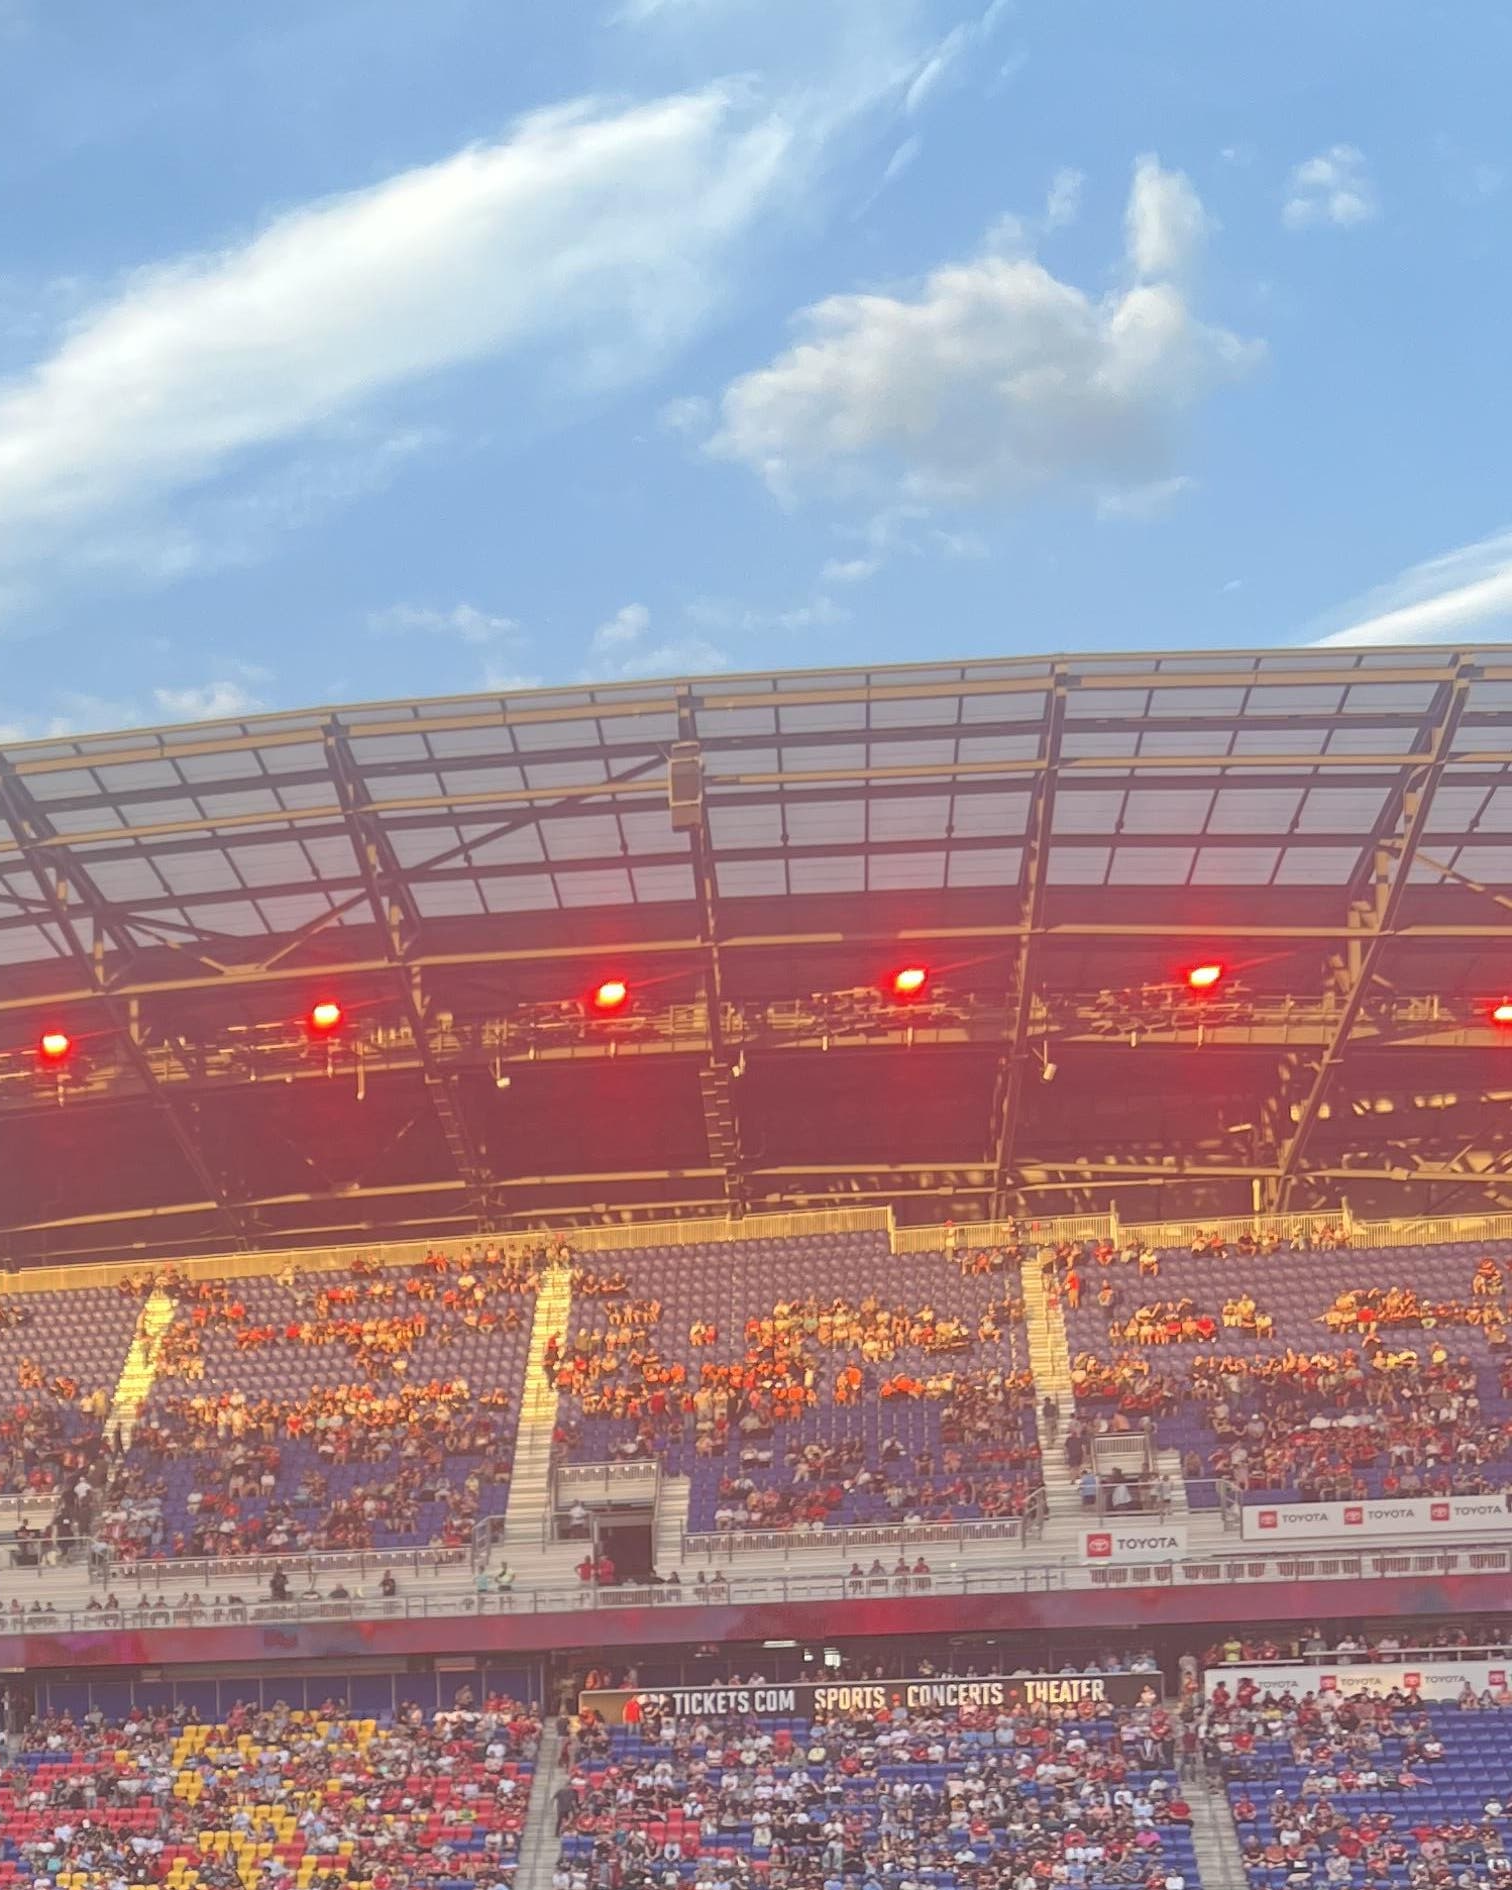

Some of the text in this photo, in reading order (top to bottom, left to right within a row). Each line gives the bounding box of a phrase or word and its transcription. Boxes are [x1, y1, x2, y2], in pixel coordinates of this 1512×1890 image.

[1368, 1506, 1414, 1519] TOYOTA
[1455, 1505, 1502, 1516] TOYOTA
[1282, 1513, 1328, 1524] TOYOTA
[1117, 1537, 1178, 1550] TOYOTA
[1258, 1680, 1299, 1689] TOYOTA
[1341, 1676, 1382, 1687] TOYOTA
[1425, 1674, 1466, 1684] TOYOTA
[815, 1686, 886, 1710] SPORTS
[907, 1682, 1003, 1708] CONCERTS
[1024, 1679, 1105, 1704] THEATER
